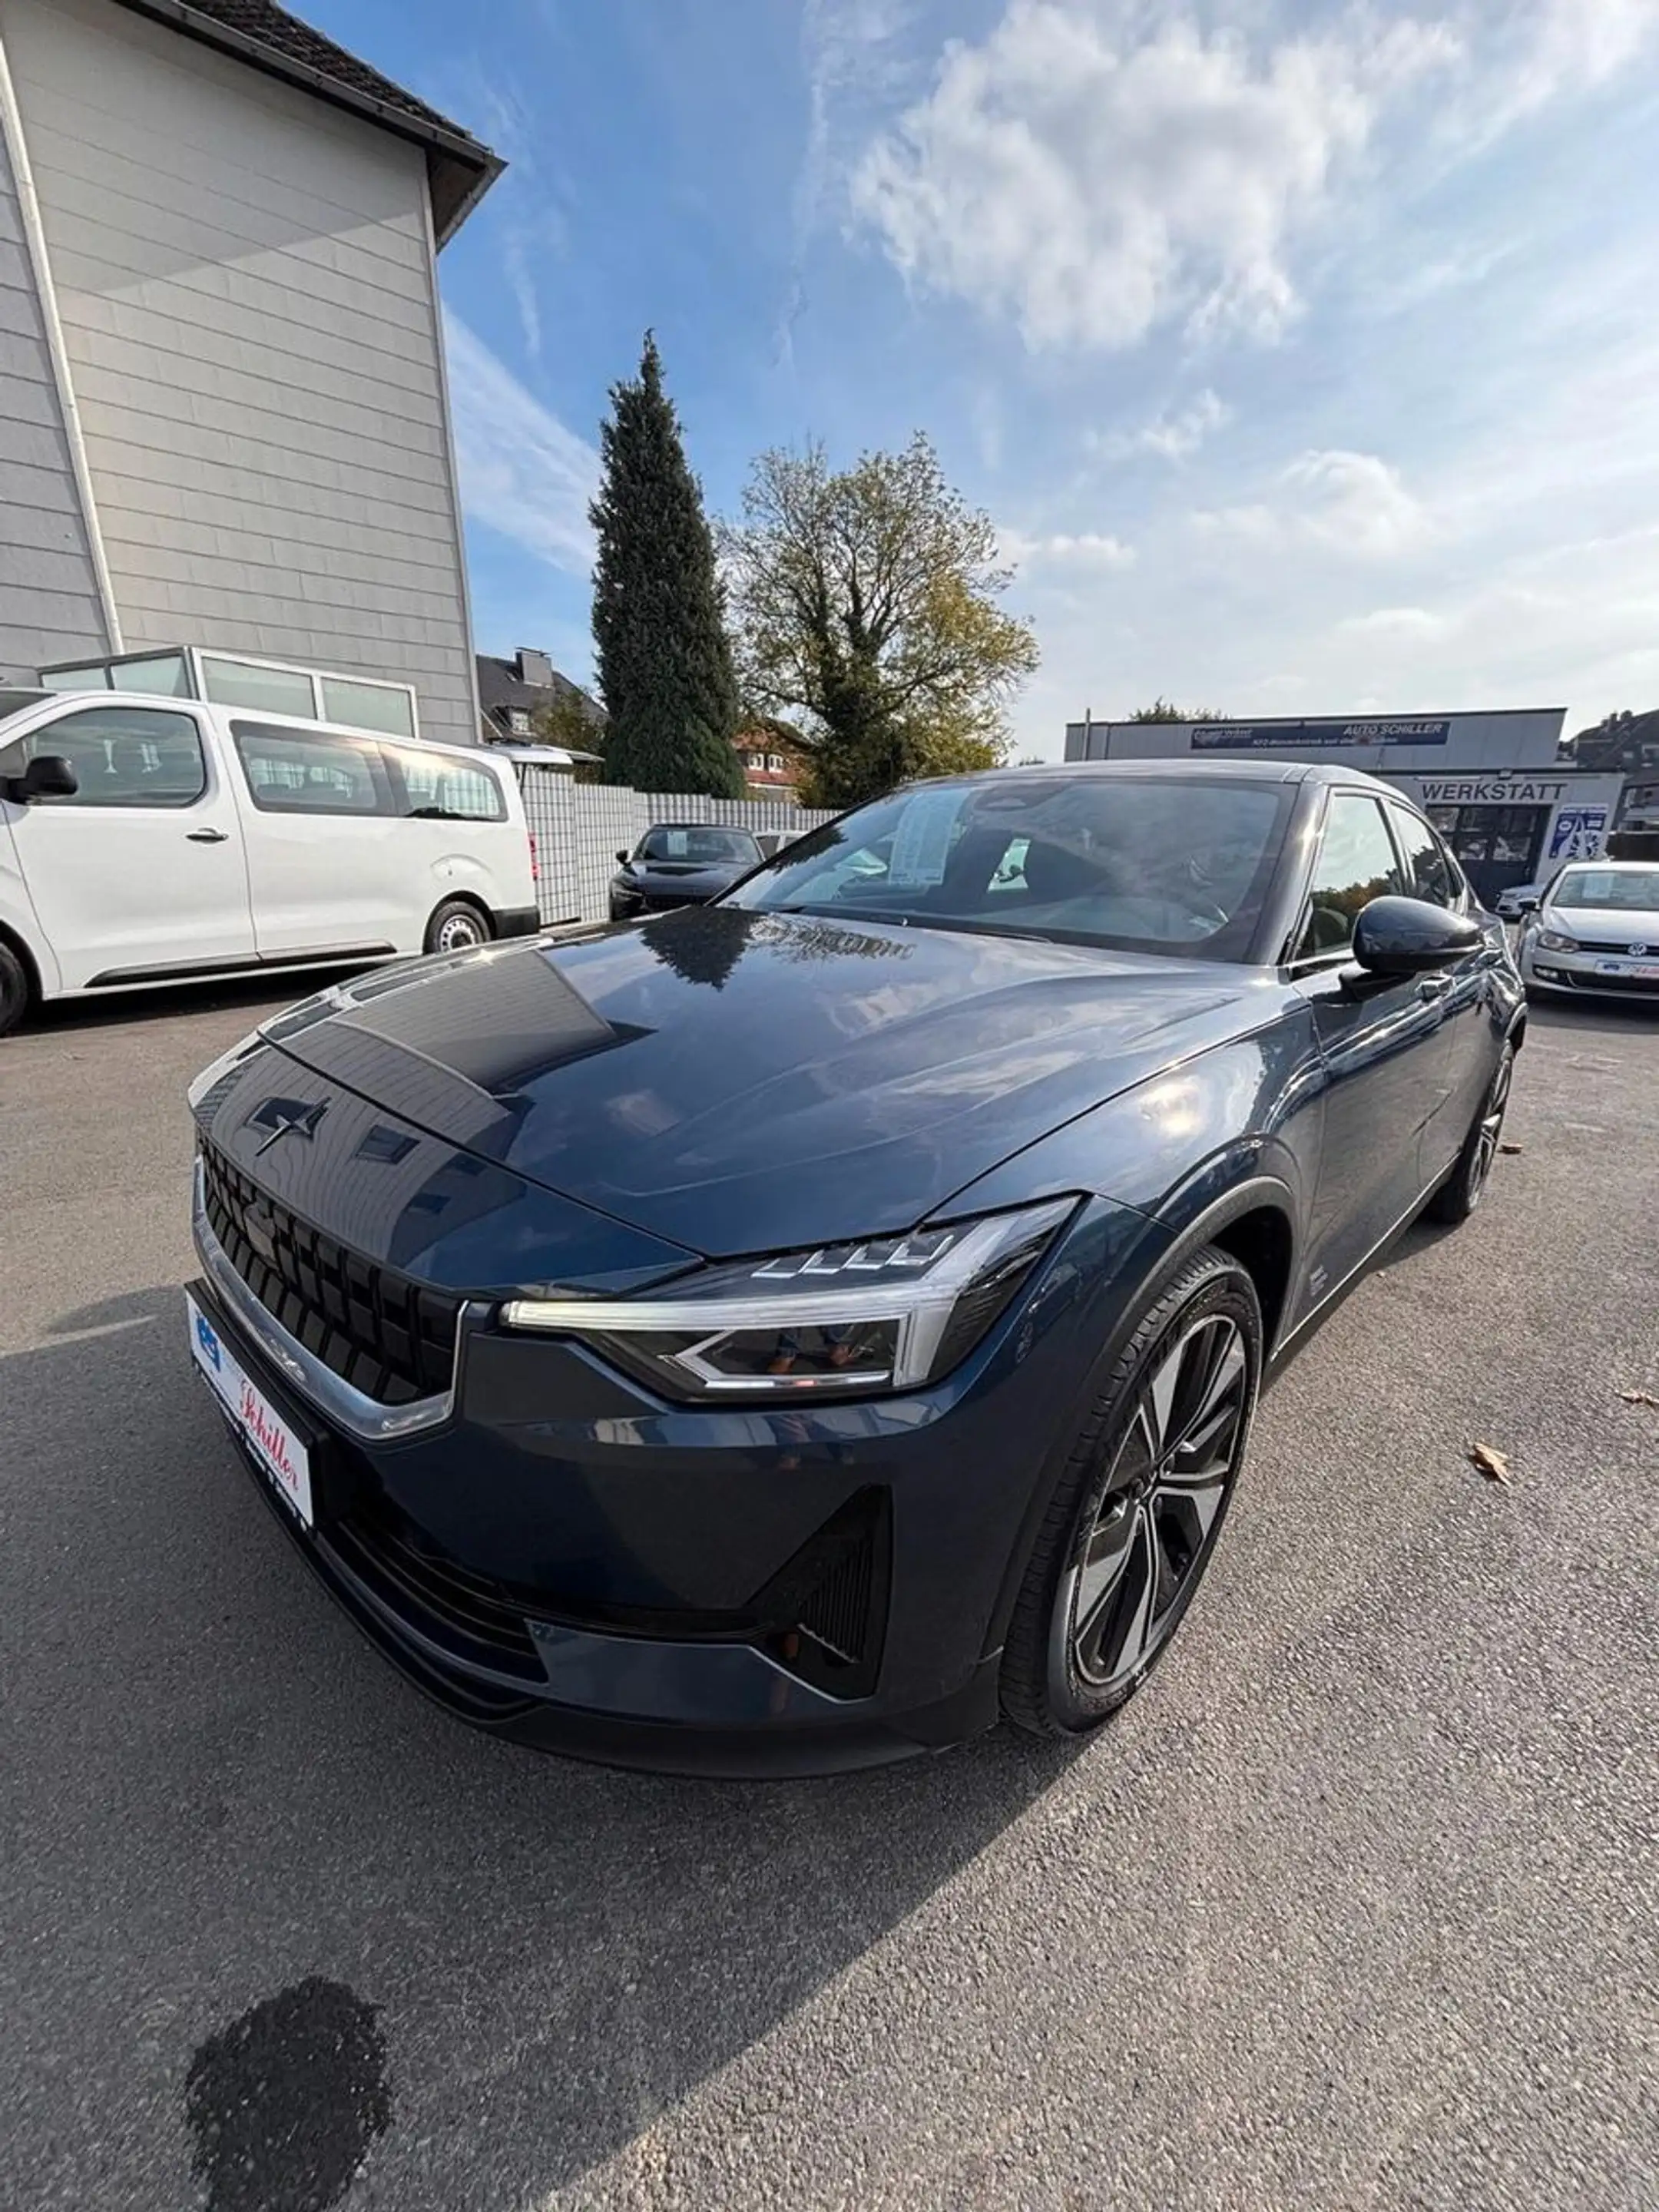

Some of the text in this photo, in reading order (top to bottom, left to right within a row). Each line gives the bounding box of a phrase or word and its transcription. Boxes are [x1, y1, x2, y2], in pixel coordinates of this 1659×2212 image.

[1343, 724, 1442, 735] AUTO SCHILLER
[1422, 783, 1568, 800] WERKSTATT
[240, 1379, 299, 1492] Schiller
